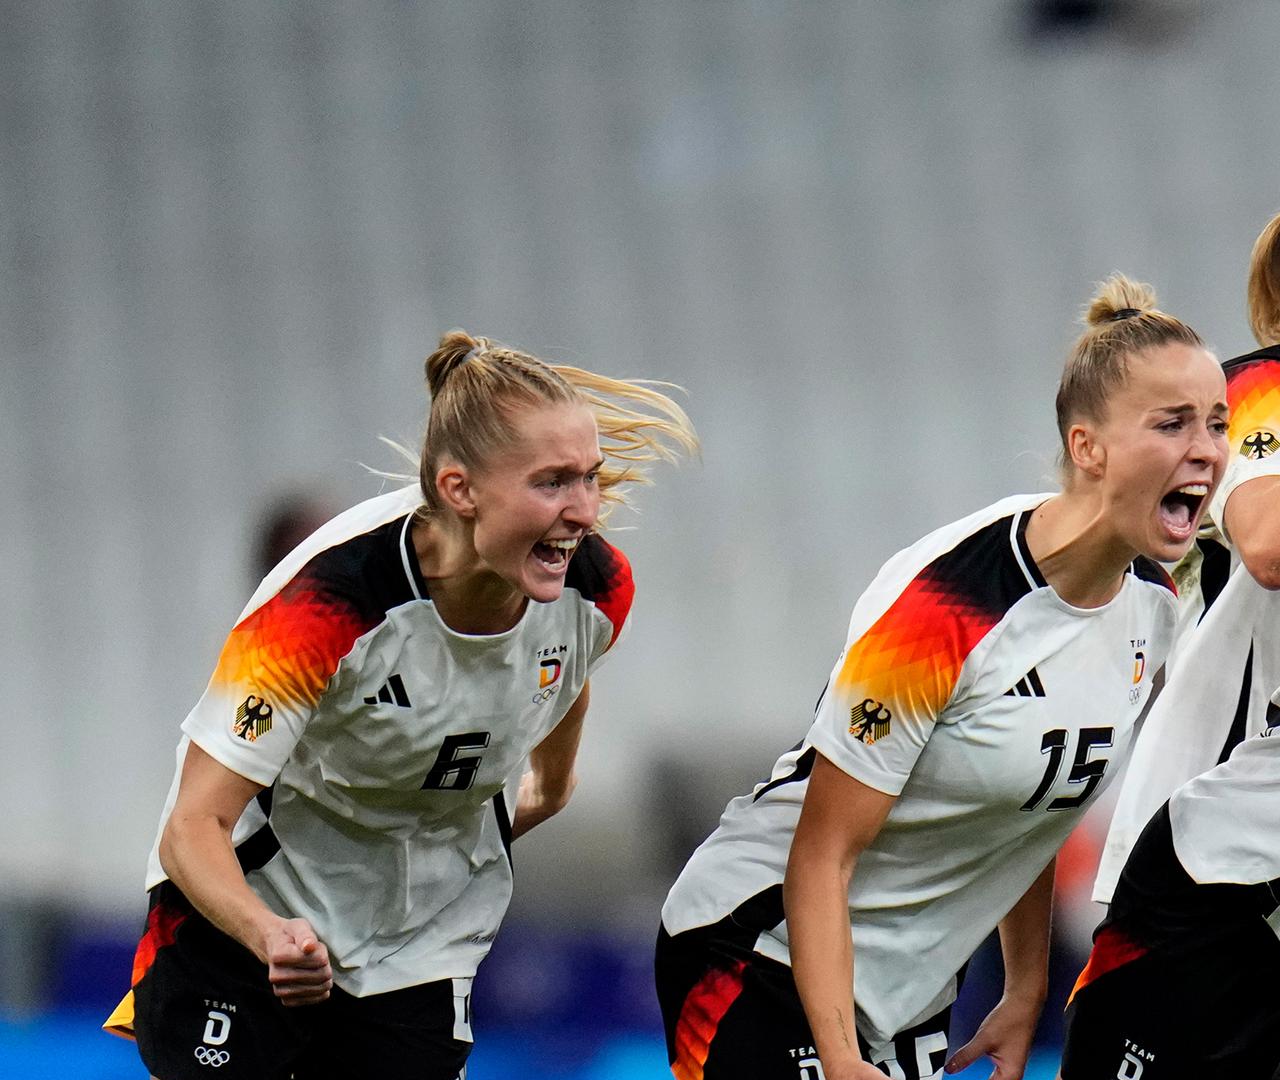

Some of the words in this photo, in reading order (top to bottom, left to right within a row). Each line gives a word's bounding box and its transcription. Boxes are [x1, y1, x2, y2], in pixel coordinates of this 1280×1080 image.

[537, 645, 567, 658] TEAM
[539, 658, 562, 689] D
[1133, 651, 1146, 684] D
[420, 731, 491, 791] 6
[1019, 726, 1115, 811] 15
[204, 999, 237, 1013] TEAM
[203, 1010, 231, 1046] D
[788, 1046, 816, 1058] TEA
[1124, 1038, 1156, 1063] TEAM
